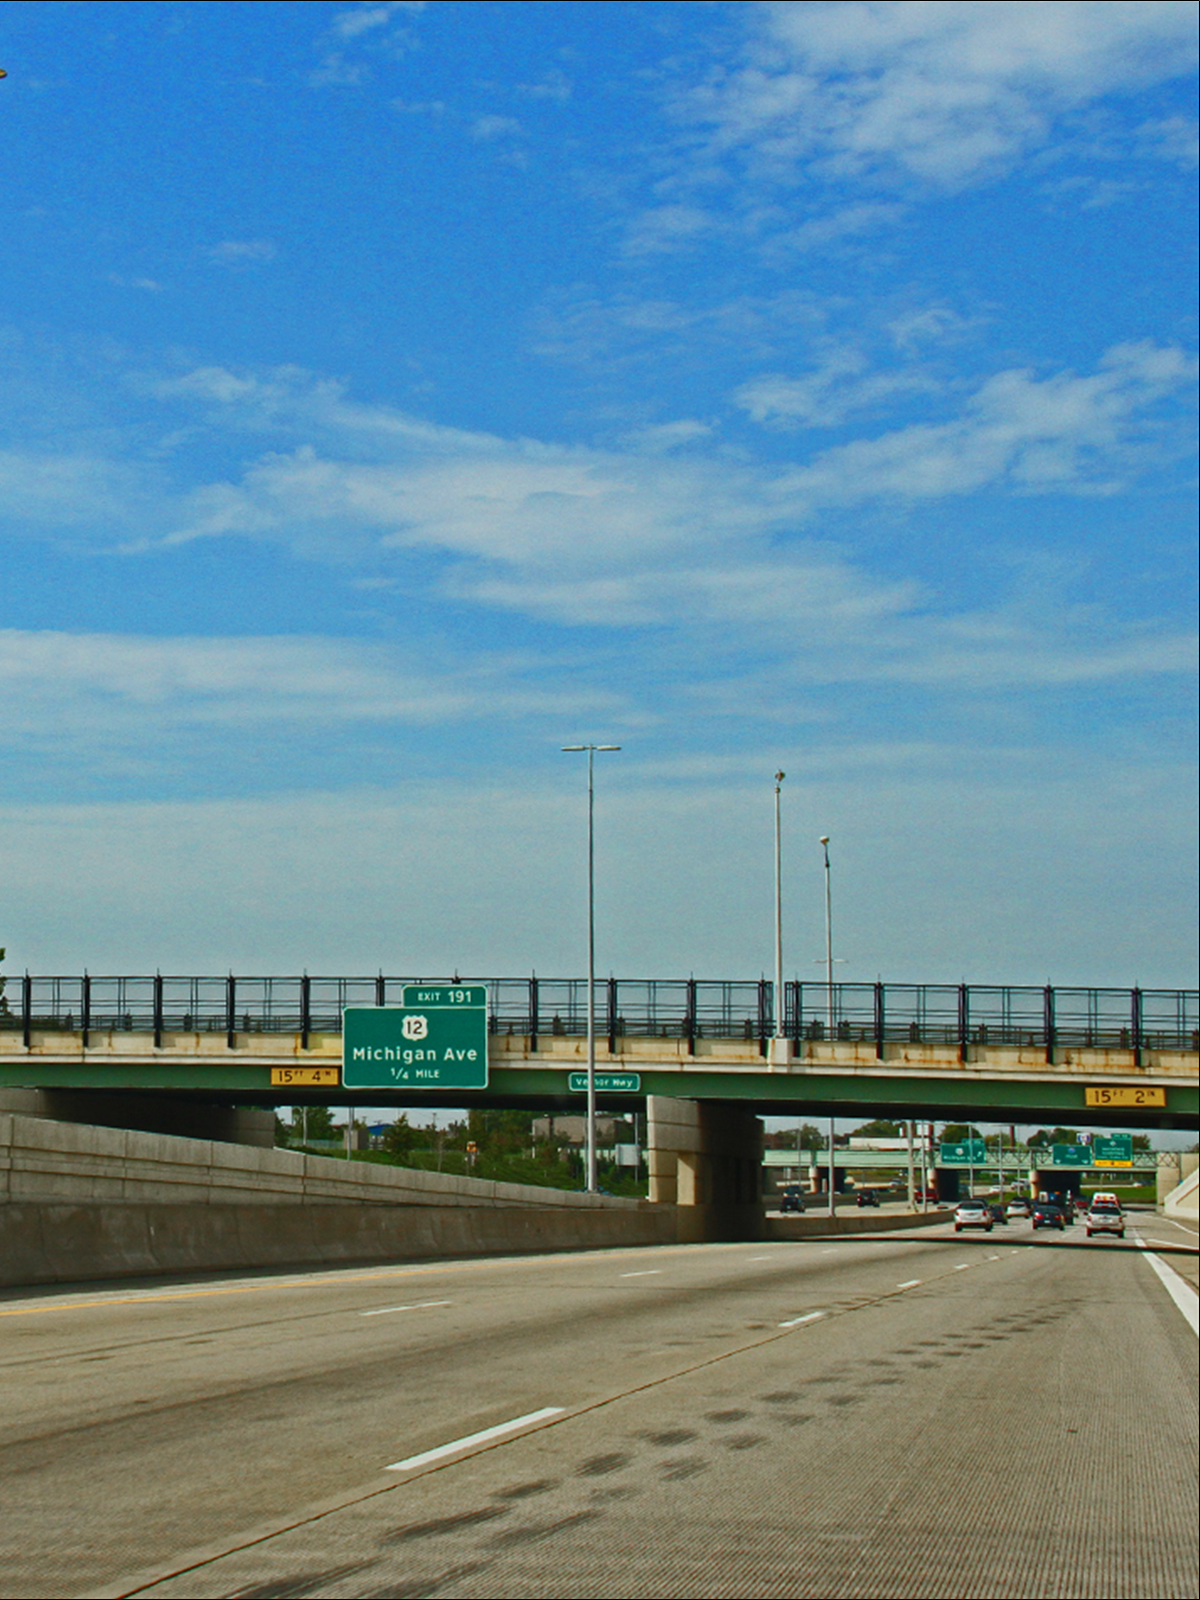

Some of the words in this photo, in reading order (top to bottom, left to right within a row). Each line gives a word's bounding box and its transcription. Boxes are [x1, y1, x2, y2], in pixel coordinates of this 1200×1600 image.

[417, 992, 441, 1002] EXIT
[448, 990, 472, 1003] 191
[406, 1020, 423, 1035] 12
[352, 1046, 437, 1065] Michigan
[443, 1048, 478, 1062] Ave
[416, 1069, 440, 1079] MILE
